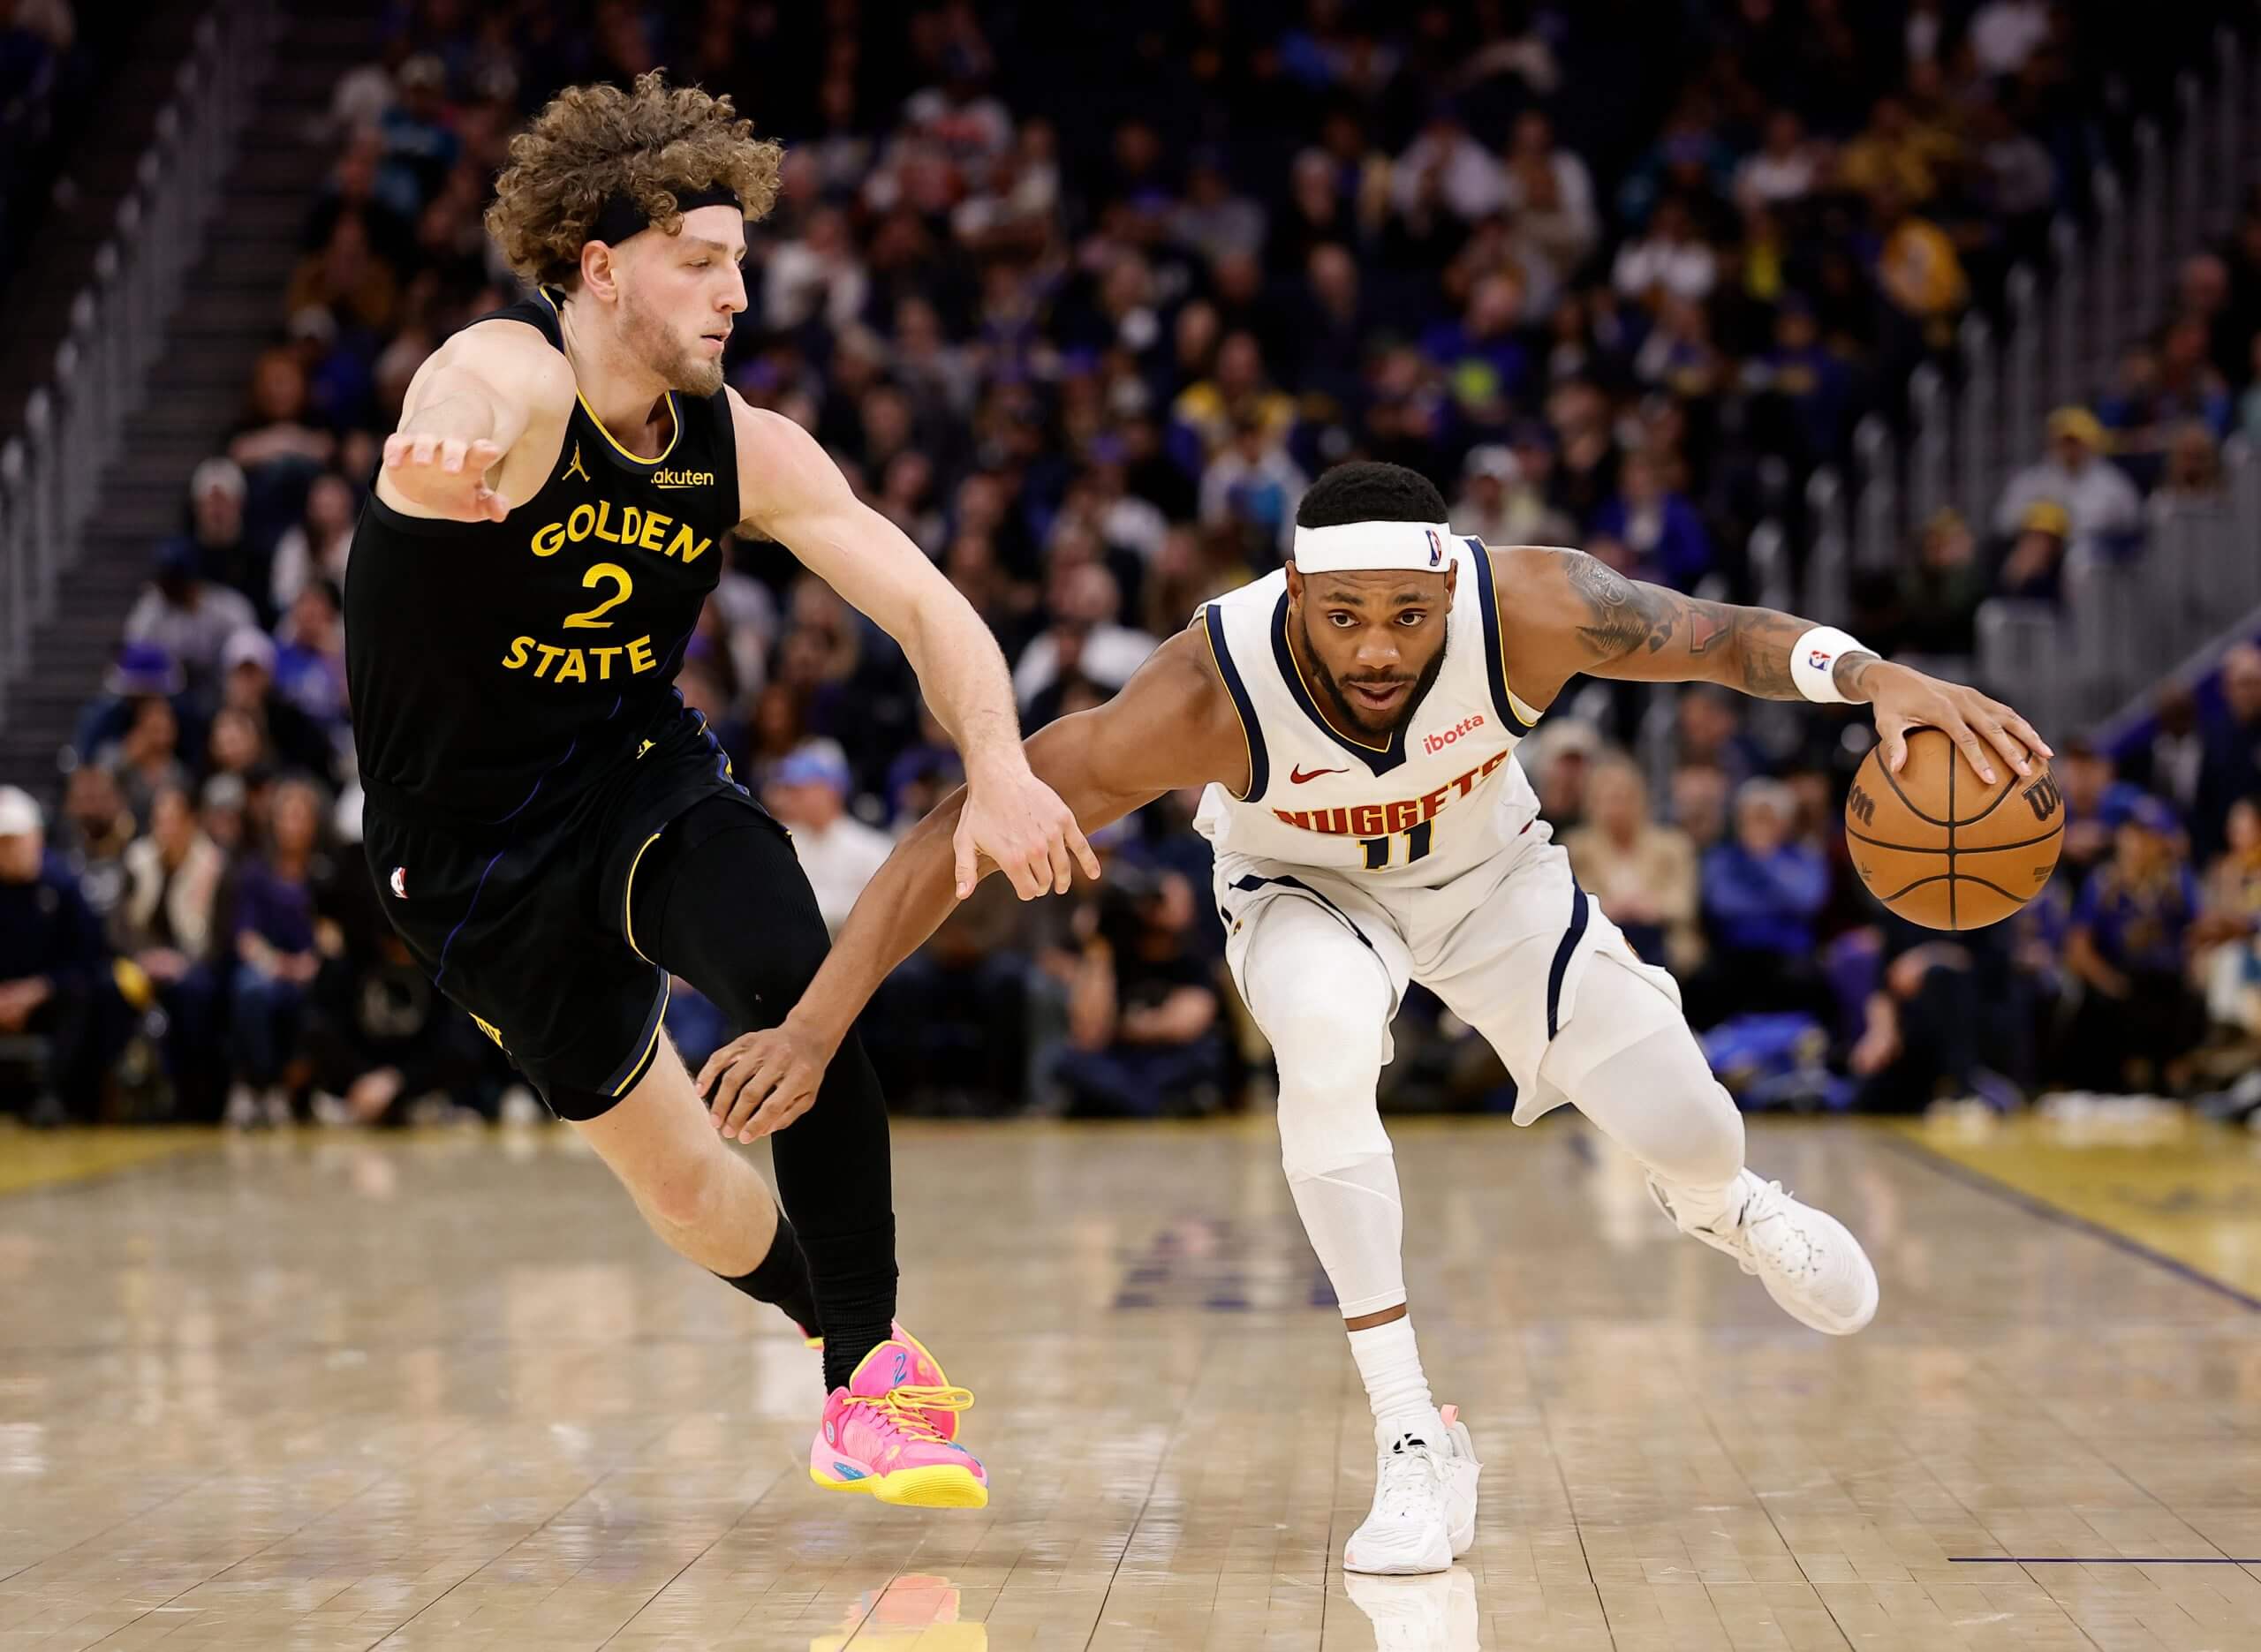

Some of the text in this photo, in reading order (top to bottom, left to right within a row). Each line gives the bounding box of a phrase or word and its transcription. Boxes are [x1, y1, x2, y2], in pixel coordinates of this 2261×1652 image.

[531, 500, 712, 563] GOLDEN
[563, 562, 633, 630] 2
[502, 634, 657, 683] STATE
[1423, 715, 1484, 755] ibotta
[1357, 818, 1434, 873] 11
